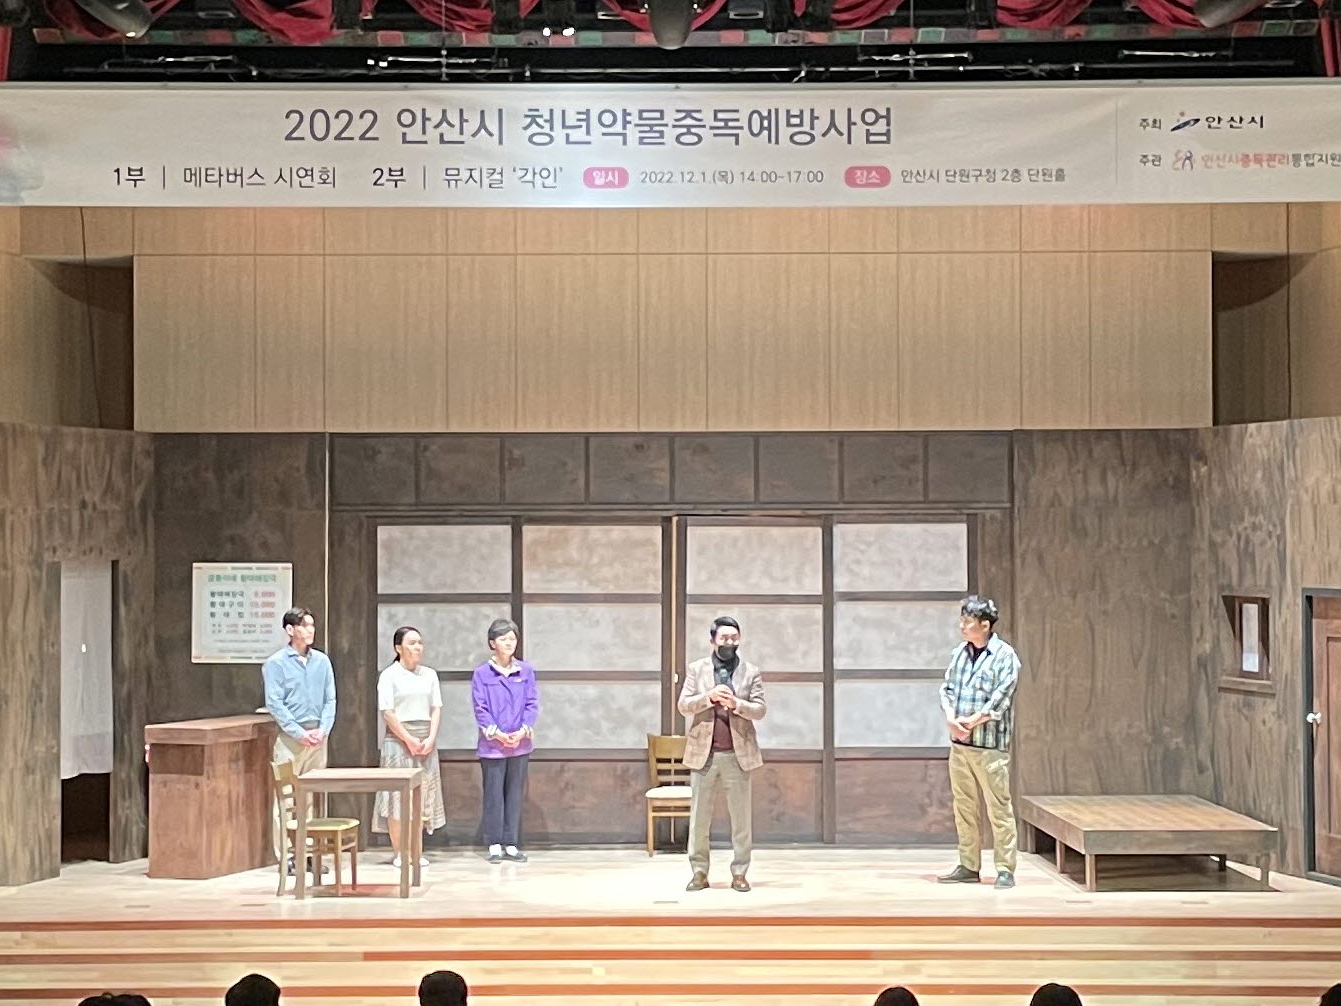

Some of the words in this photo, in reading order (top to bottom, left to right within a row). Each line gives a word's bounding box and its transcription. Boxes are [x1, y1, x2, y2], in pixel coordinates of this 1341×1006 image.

[283, 108, 380, 142] 2022
[396, 107, 504, 146] 안산시
[521, 107, 892, 147] 청년약물중독예방사업
[1205, 115, 1265, 130] 안산시
[113, 166, 146, 188] 1부
[182, 166, 266, 189] 메타버스
[274, 166, 336, 189] 시연회
[372, 167, 407, 188] 2부
[443, 166, 505, 190] 뮤지컬
[592, 170, 619, 186] 일시
[854, 169, 881, 185] 장소
[900, 168, 940, 184] 안산시
[944, 168, 997, 184] 단원구청
[1001, 168, 1022, 183] 2층
